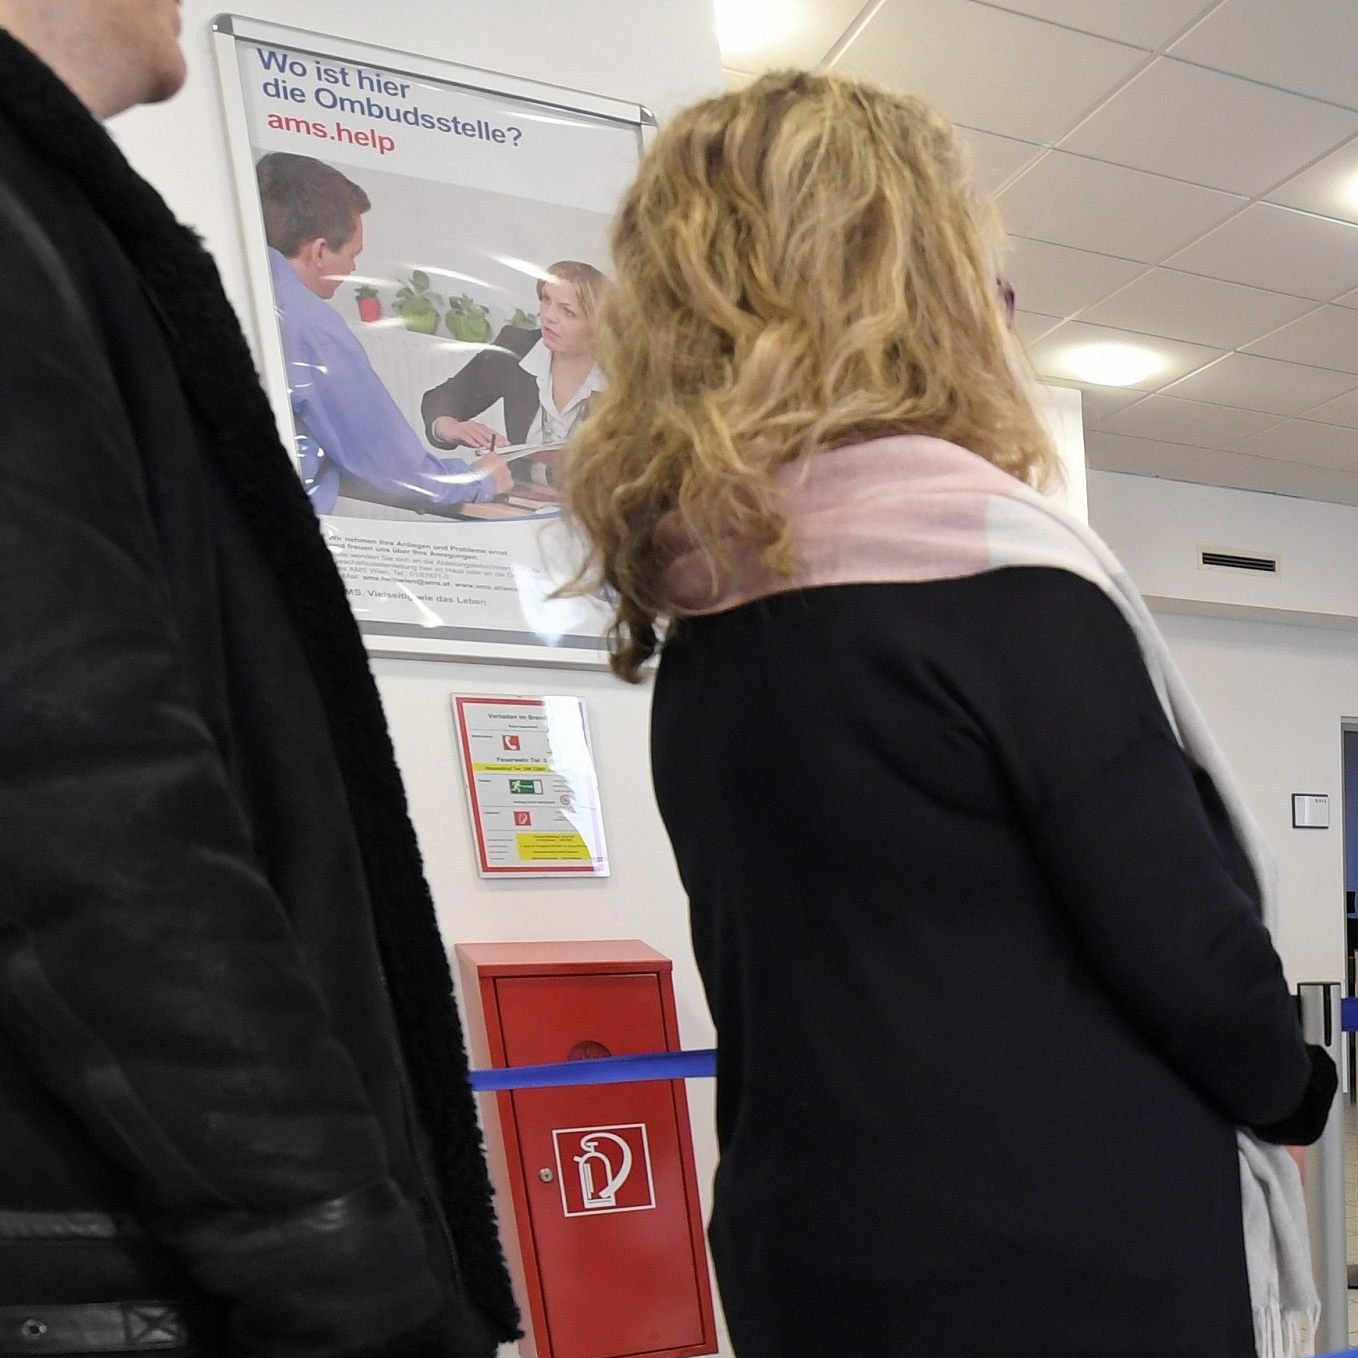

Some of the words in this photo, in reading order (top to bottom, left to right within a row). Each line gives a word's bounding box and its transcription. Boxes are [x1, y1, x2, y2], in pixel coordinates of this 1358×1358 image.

[257, 47, 307, 77] Wo
[315, 60, 350, 87] ist
[357, 70, 410, 98] hier
[263, 78, 306, 103] die
[314, 87, 522, 147] Ombudsstelle?
[268, 113, 396, 154] ams.help
[450, 545, 486, 554] Probleme
[436, 595, 454, 603] das
